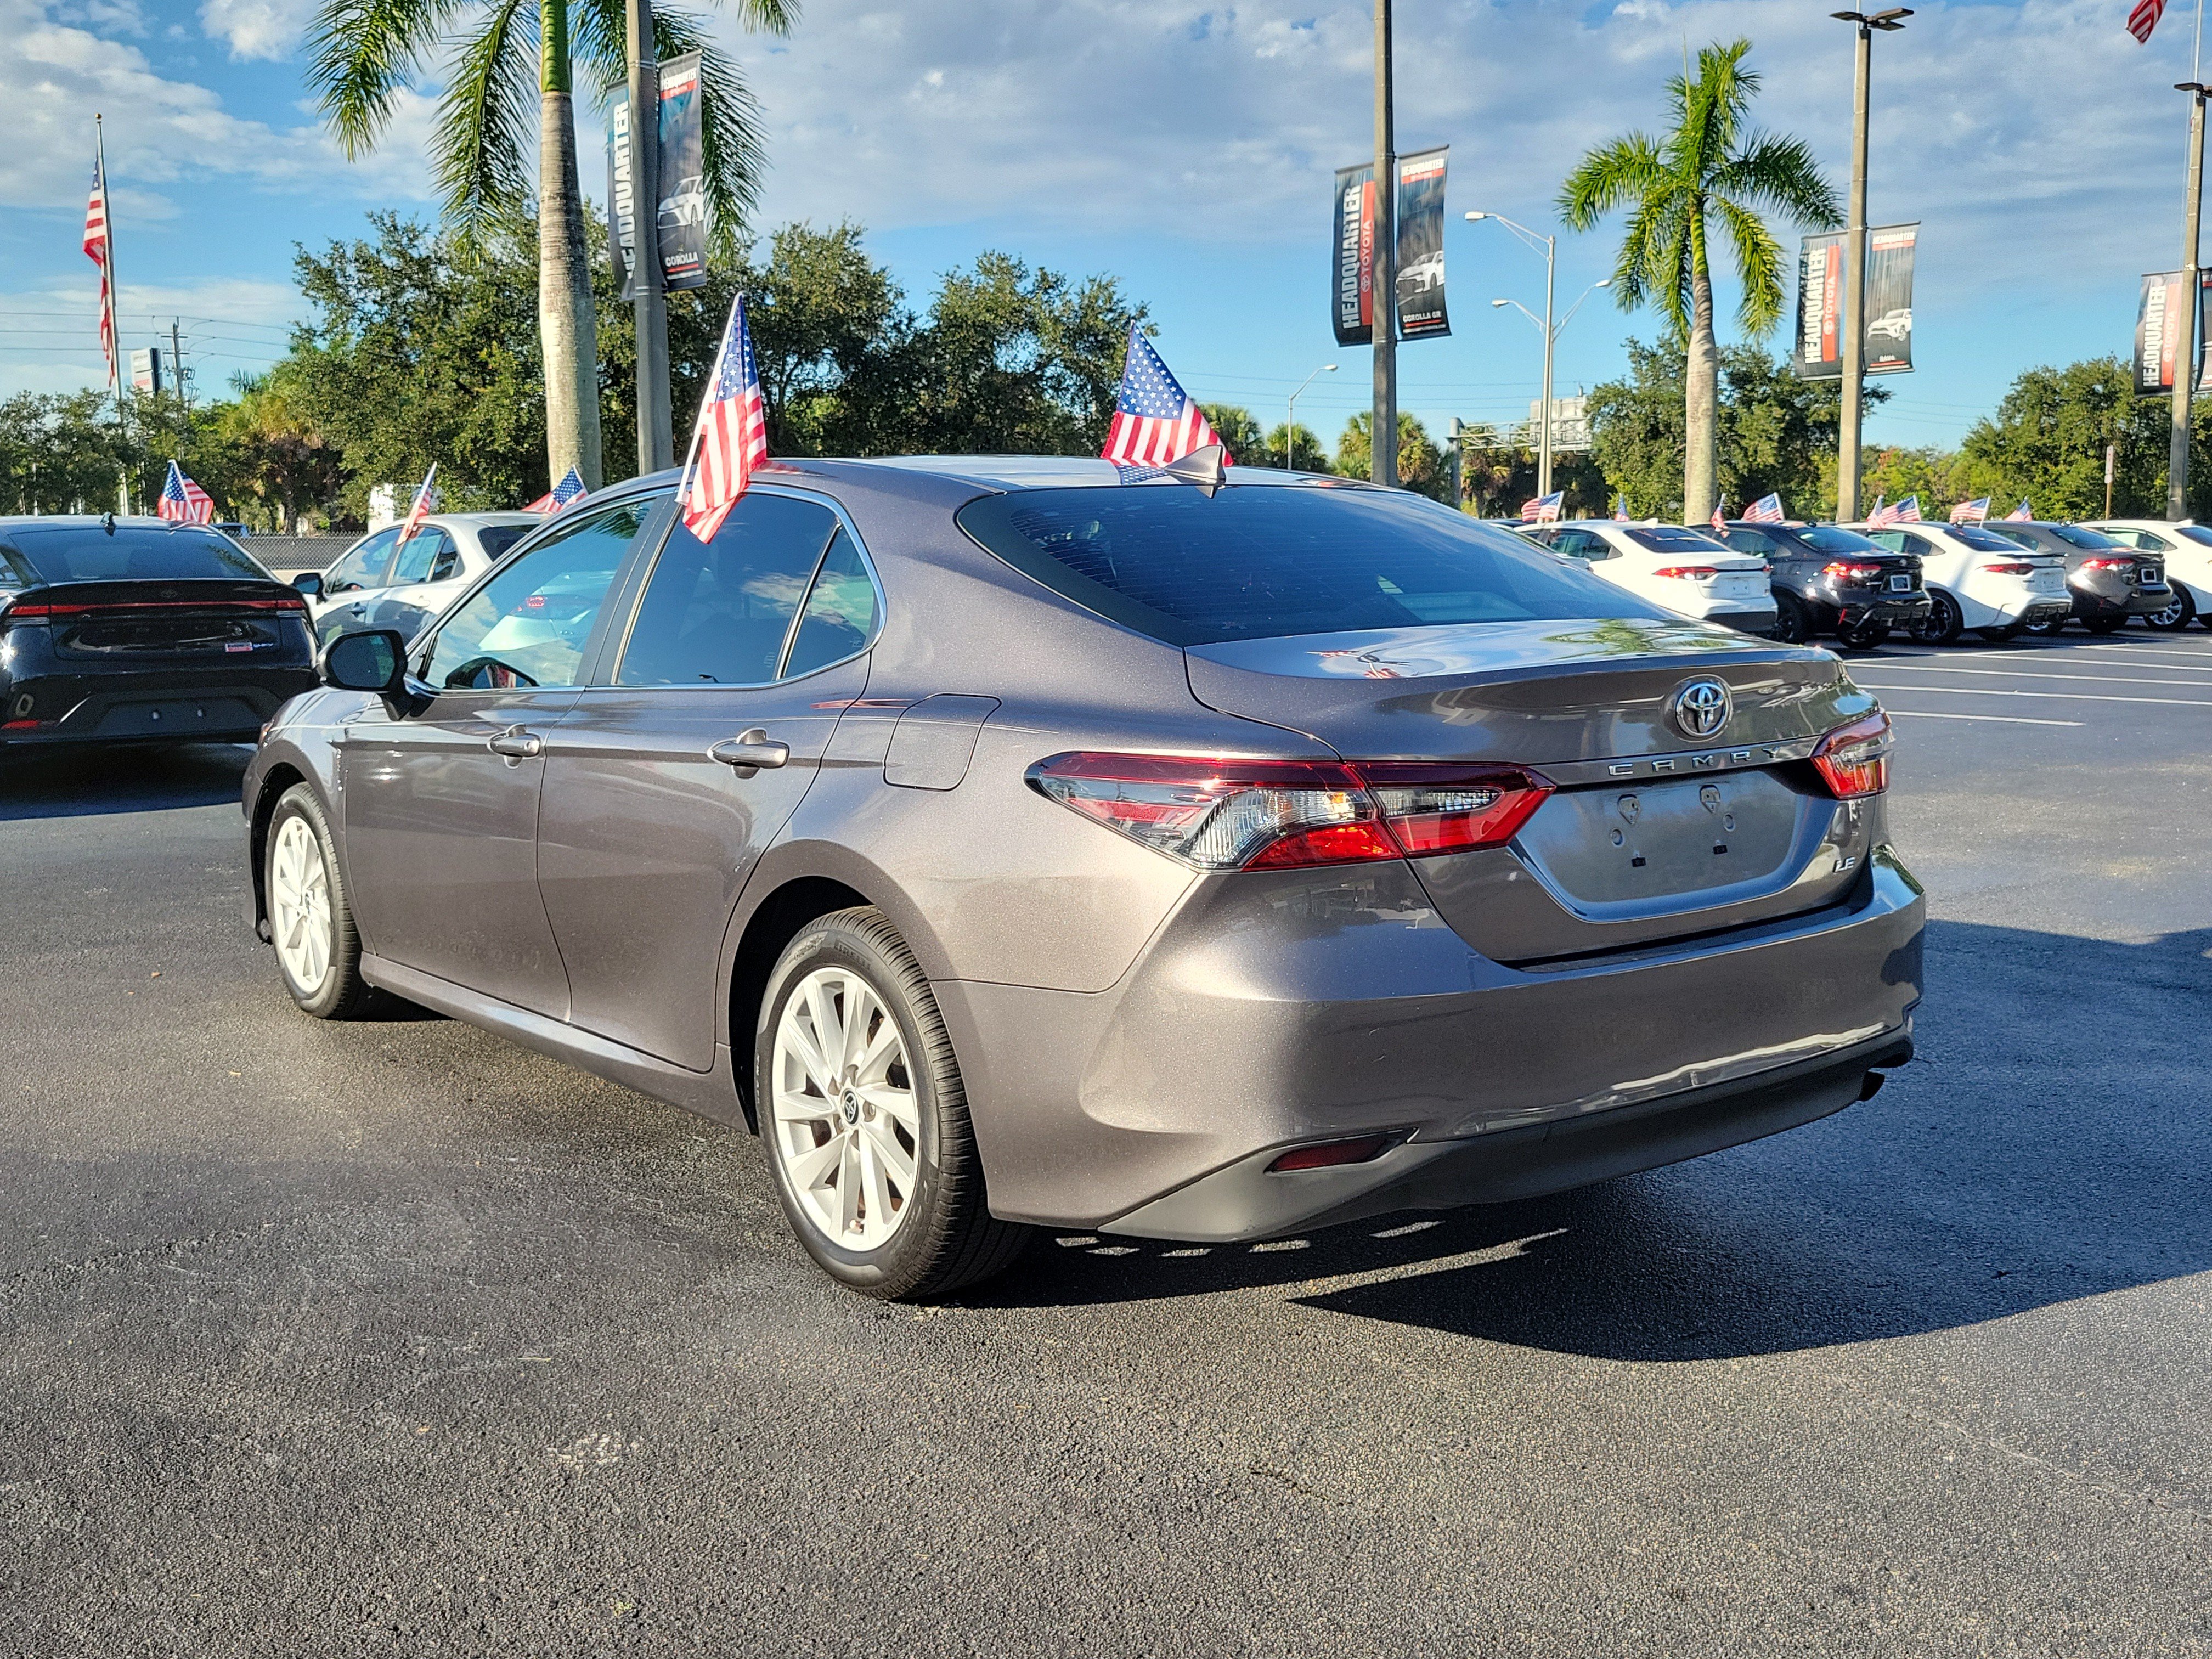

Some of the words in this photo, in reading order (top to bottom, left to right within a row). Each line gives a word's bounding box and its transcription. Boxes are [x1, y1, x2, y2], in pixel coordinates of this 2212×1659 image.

[664, 251, 699, 267] COROLLA
[1341, 184, 1361, 329] HEADQUARTER
[1362, 220, 1372, 274] TOYOTA
[1804, 248, 1826, 364] HEADQUARTER
[1825, 275, 1835, 319] TOYOTA
[2143, 285, 2166, 386] HEADQUARTER
[1608, 746, 1781, 776] CAMRY
[1833, 856, 1857, 872] LE
